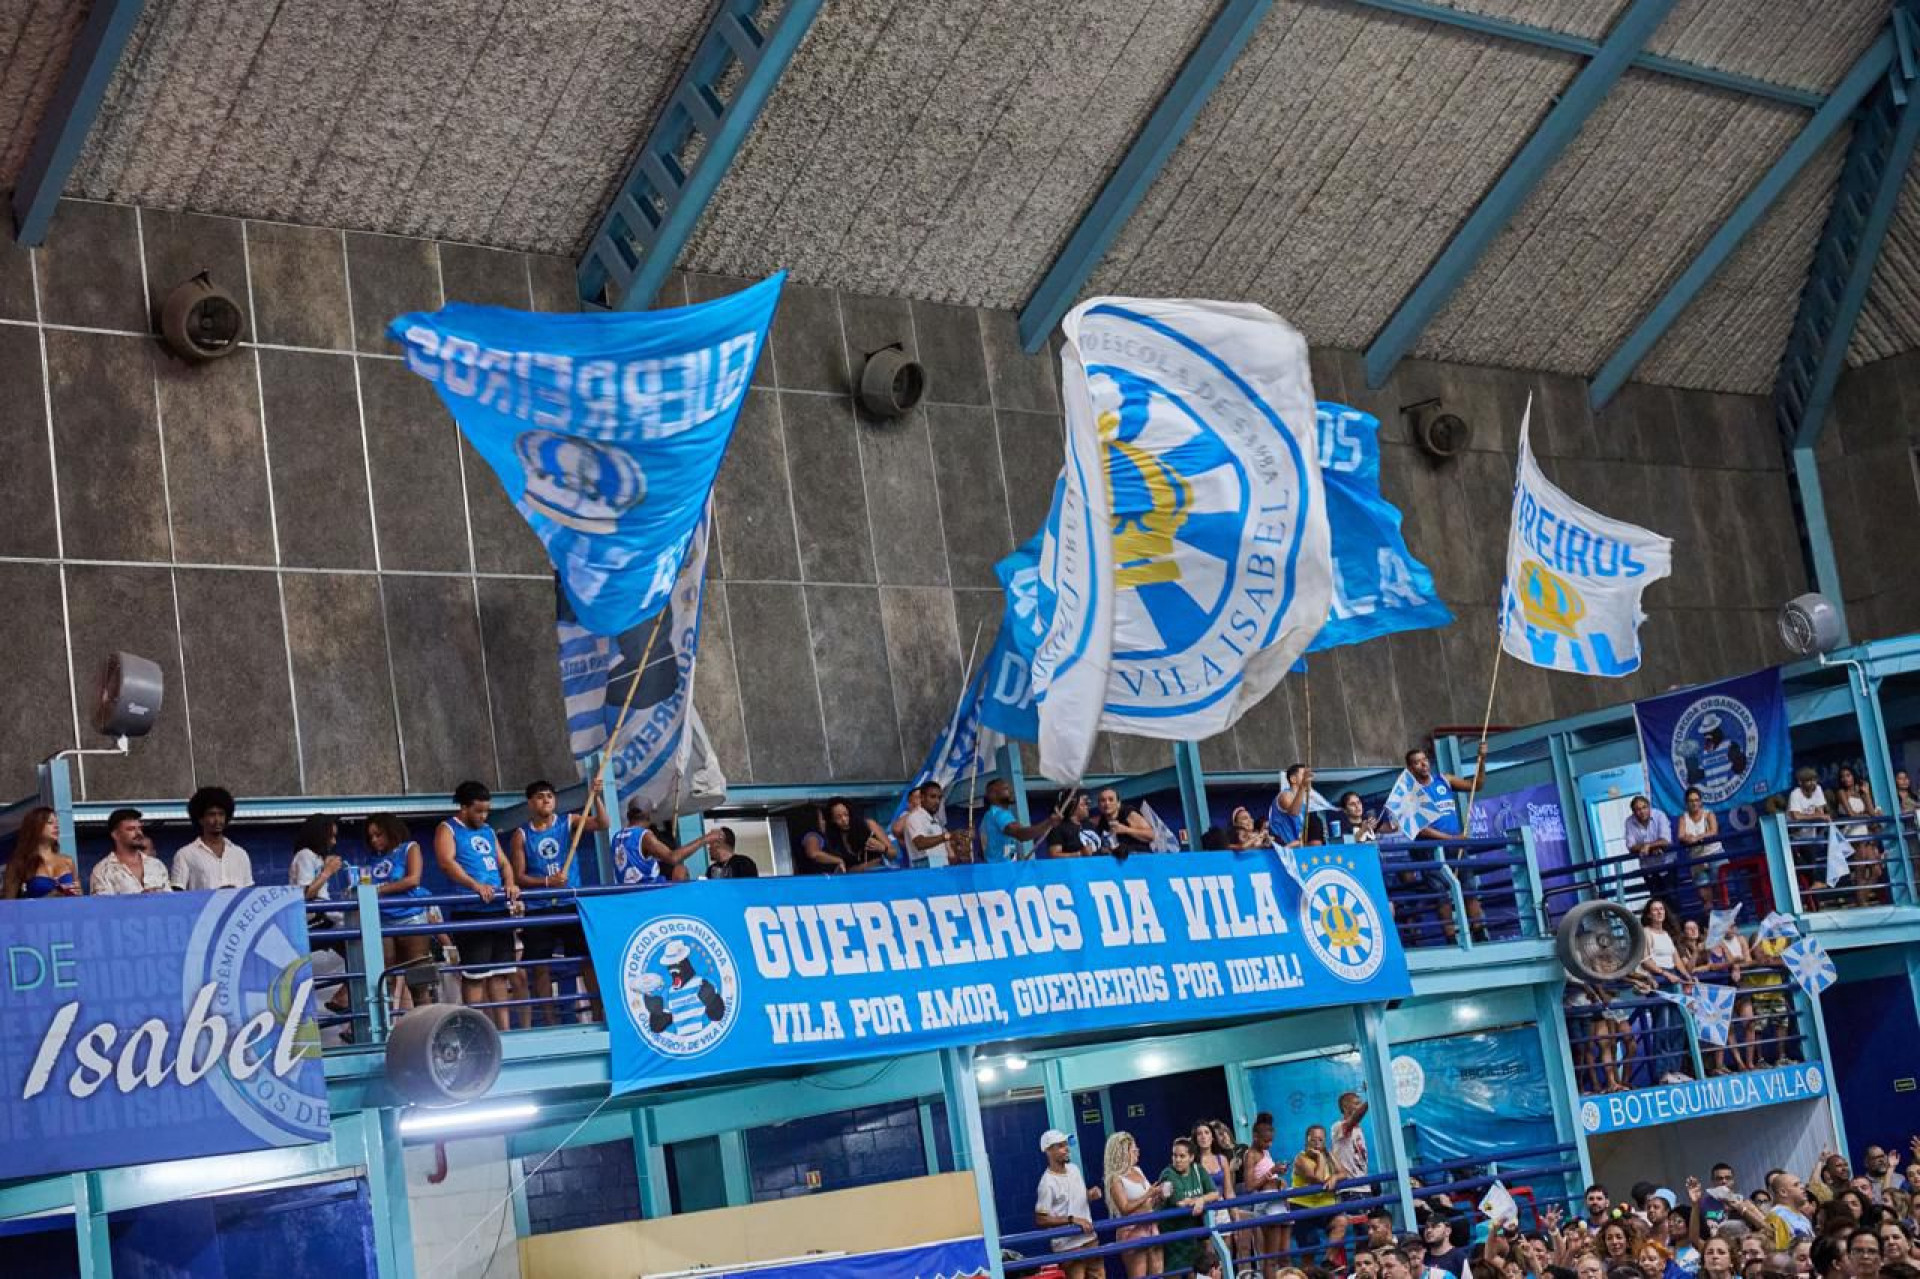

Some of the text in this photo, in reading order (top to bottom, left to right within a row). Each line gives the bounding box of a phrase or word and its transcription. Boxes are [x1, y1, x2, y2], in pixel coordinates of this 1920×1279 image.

[1119, 488, 1290, 697] VILA ISABEL
[9, 942, 79, 990] DE
[628, 923, 727, 979] TORCIDA ORGANIZADA
[744, 883, 1083, 979] GUERREIROS
[1089, 878, 1166, 948] DA
[1170, 872, 1288, 942] VILA
[23, 979, 314, 1100] Isabel
[765, 954, 1304, 1045] VILA POR AMOR, GUERREIROS POR IDEAL!
[1609, 1069, 1809, 1127] BOTEQUIM DA VILA
